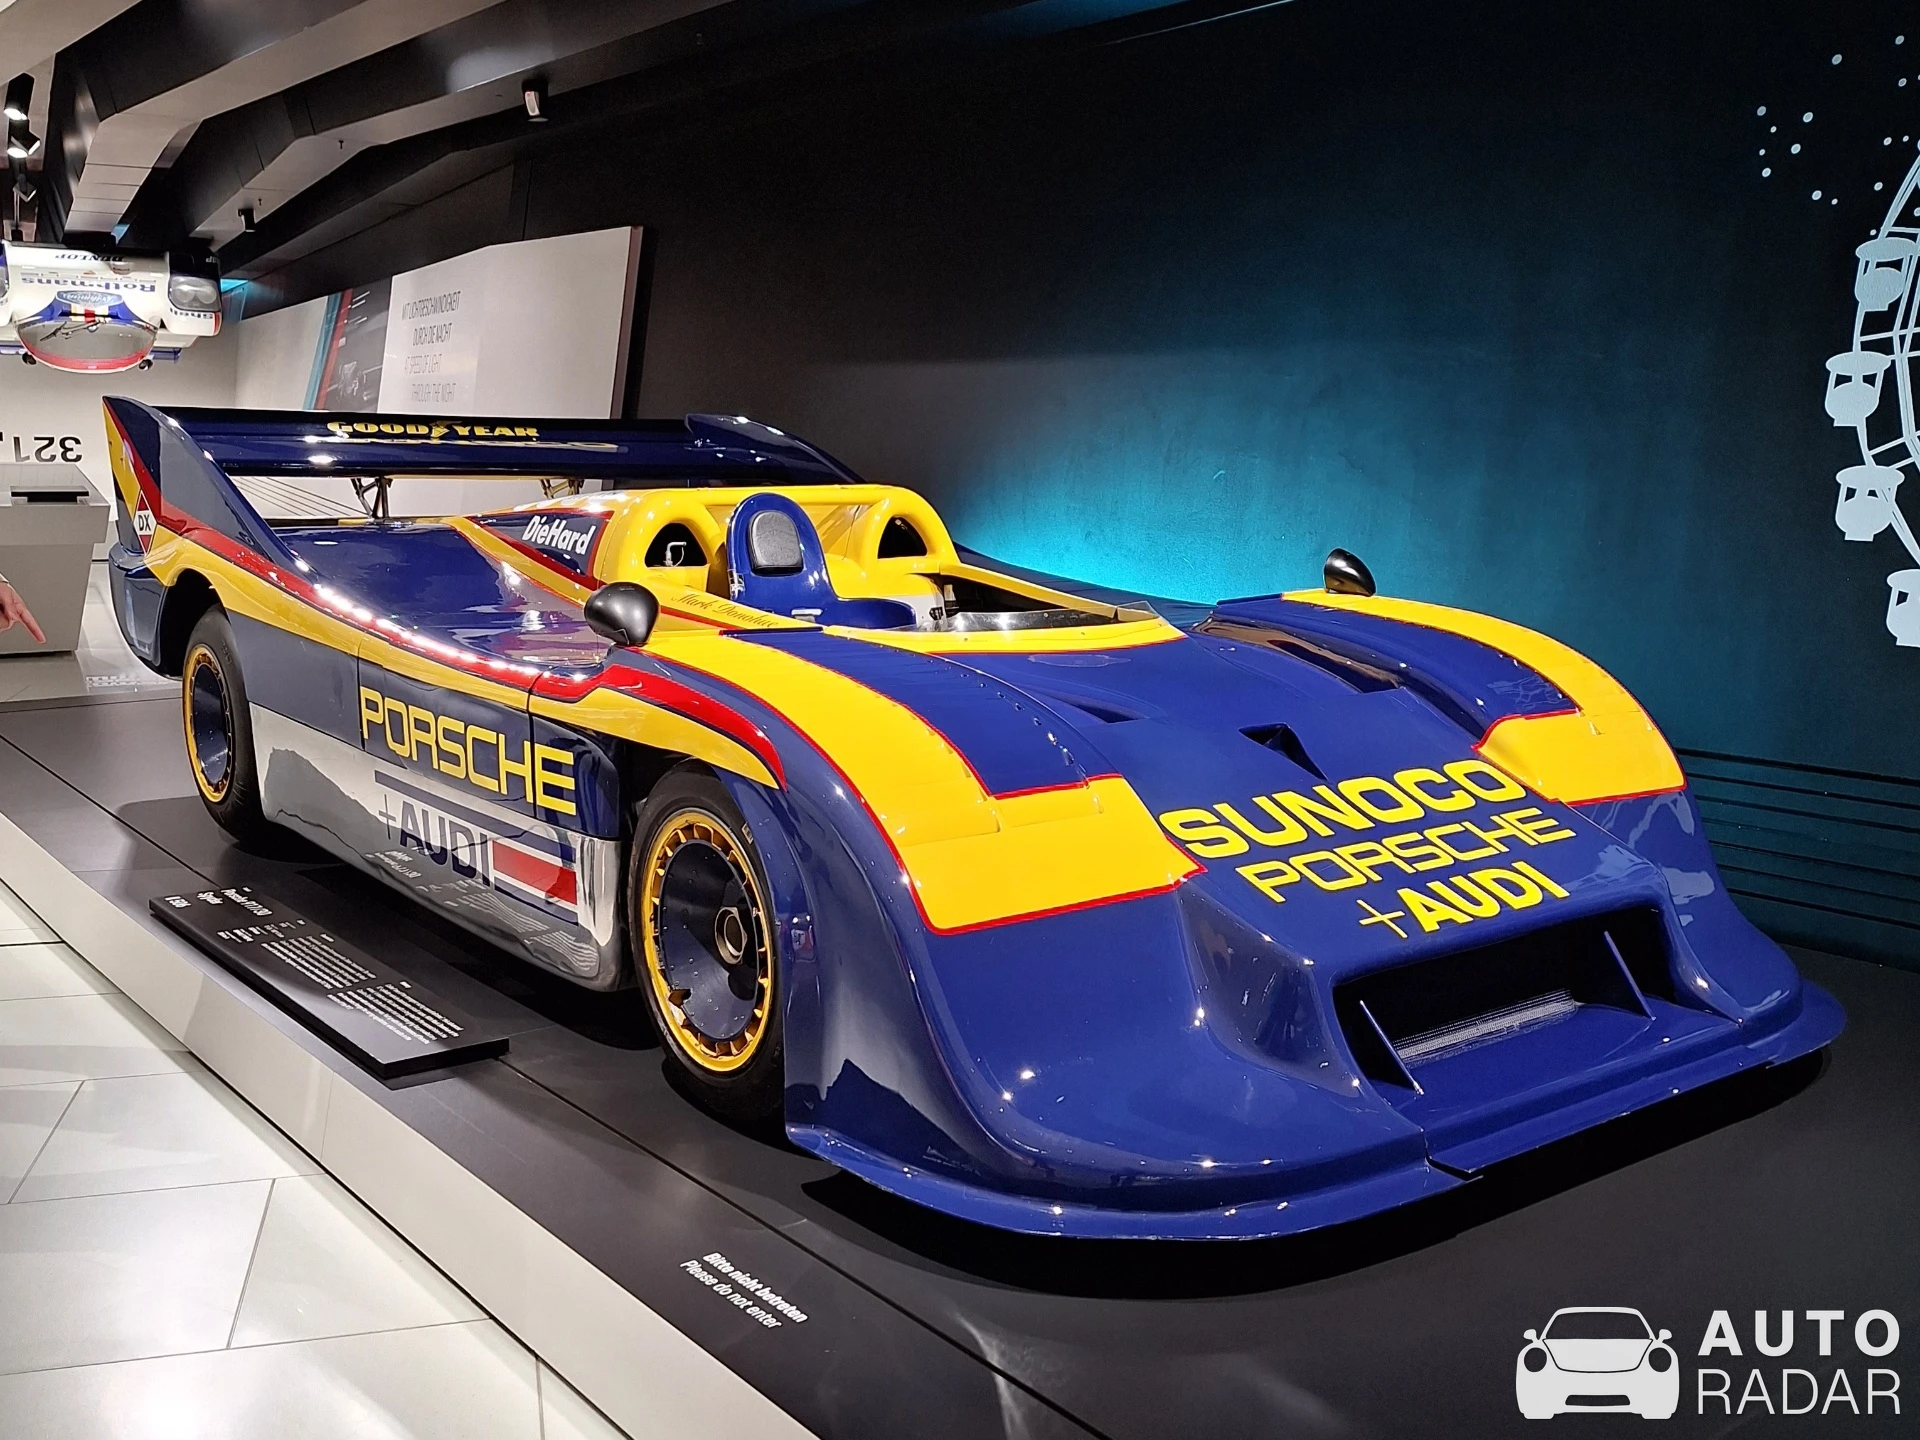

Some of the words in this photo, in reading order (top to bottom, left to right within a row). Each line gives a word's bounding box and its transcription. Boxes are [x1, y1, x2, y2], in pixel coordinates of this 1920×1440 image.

[21, 277, 156, 293] Rothmans
[54, 253, 125, 262] DUNLOP
[137, 513, 152, 532] DX
[521, 514, 597, 556] DieHard
[671, 593, 719, 610] Mark
[712, 603, 779, 628] Donohue
[360, 685, 577, 816] PORSCHE
[1159, 759, 1527, 859] SUNOCO
[1235, 807, 1577, 904] PORSCHE
[679, 1259, 719, 1286] Please
[712, 1282, 733, 1296] do
[726, 1292, 753, 1309] not
[746, 1305, 783, 1329] enter
[702, 1252, 736, 1274] Bitte
[728, 1269, 764, 1292] nicht
[755, 1286, 808, 1323] betreten
